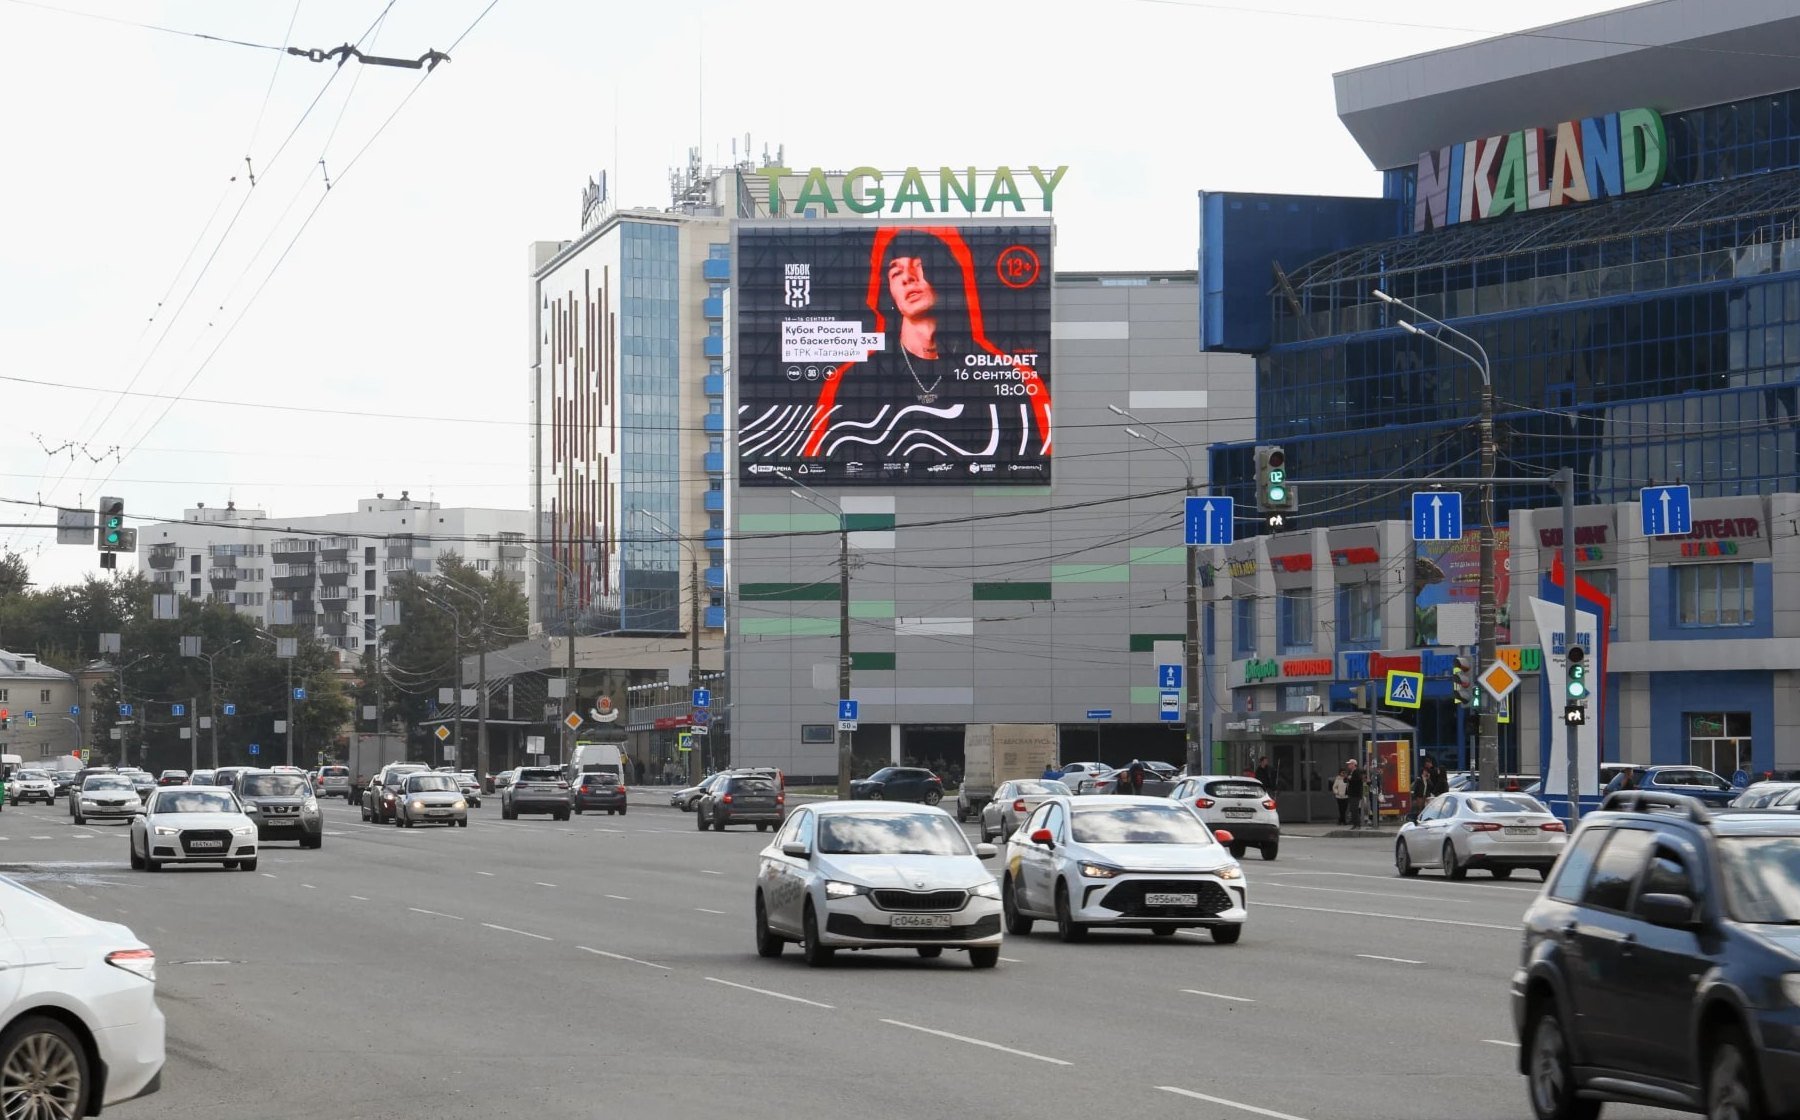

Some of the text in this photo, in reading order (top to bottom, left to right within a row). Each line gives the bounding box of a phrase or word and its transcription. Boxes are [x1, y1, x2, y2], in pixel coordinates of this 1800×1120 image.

[1414, 107, 1667, 232] NIKALAND
[756, 166, 1069, 214] TAGANAY
[785, 264, 810, 275] КУБОК
[1006, 259, 1031, 276] 12+
[786, 326, 854, 336] Кубок России
[800, 337, 858, 346] баскетболу
[794, 348, 811, 356] ТРК
[814, 348, 860, 357] «Таганай»
[965, 354, 1038, 366] OBLADAET
[954, 368, 1038, 383] 16 сентября
[994, 384, 1038, 396] 18:00
[841, 722, 851, 730] 50
